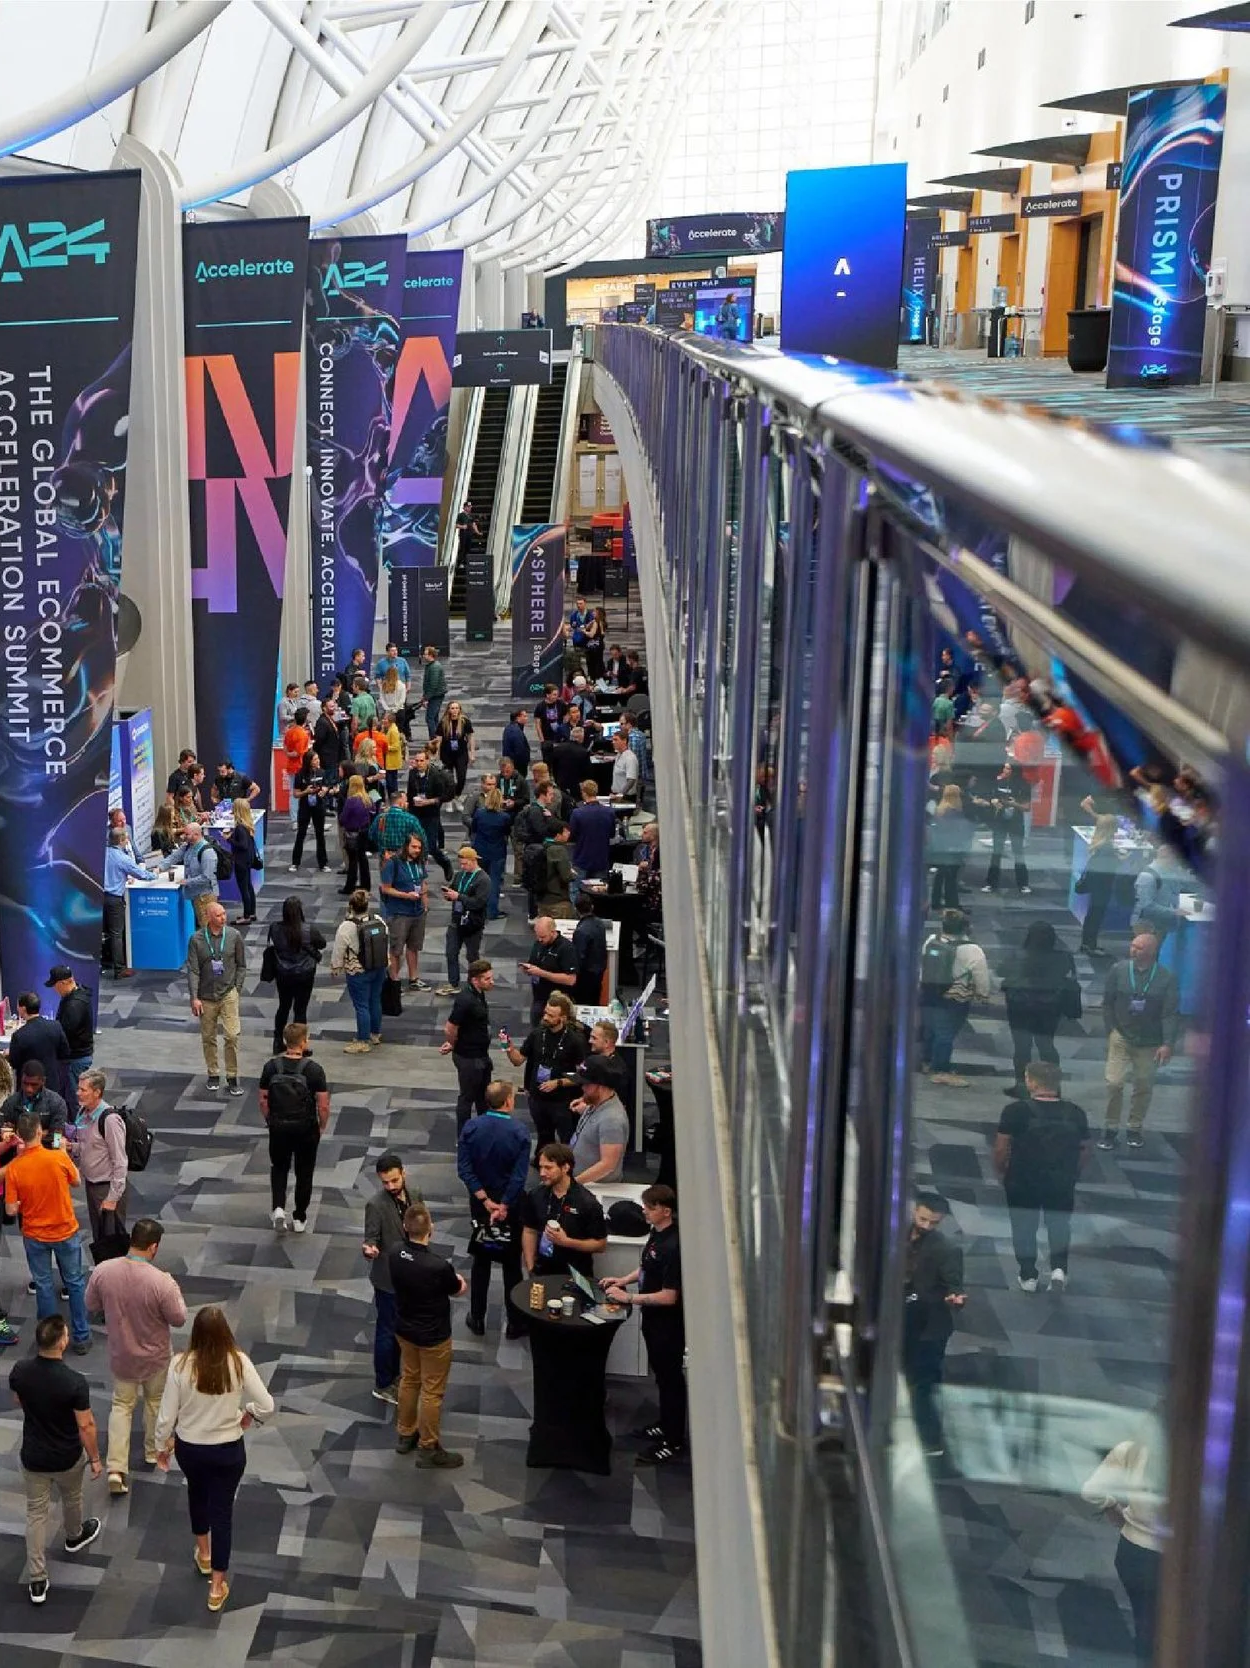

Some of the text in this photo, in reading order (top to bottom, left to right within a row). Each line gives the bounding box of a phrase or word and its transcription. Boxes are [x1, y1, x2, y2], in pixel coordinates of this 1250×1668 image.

[1024, 198, 1078, 213] Accelerate
[1150, 173, 1183, 275] PRISM
[688, 227, 737, 241] Accelerate
[195, 257, 295, 284] Accelerate
[322, 260, 389, 296] A24
[404, 274, 454, 290] celerate
[671, 279, 719, 289] EVENT MAP
[913, 257, 926, 297] HELIX
[319, 342, 336, 678] CONNECT. INNOVATE. ACCELERATE.
[28, 365, 67, 776] THE GLOBAL ECOMMERCE
[530, 559, 546, 633] SPHERE
[4, 625, 31, 743] SUMMIT
